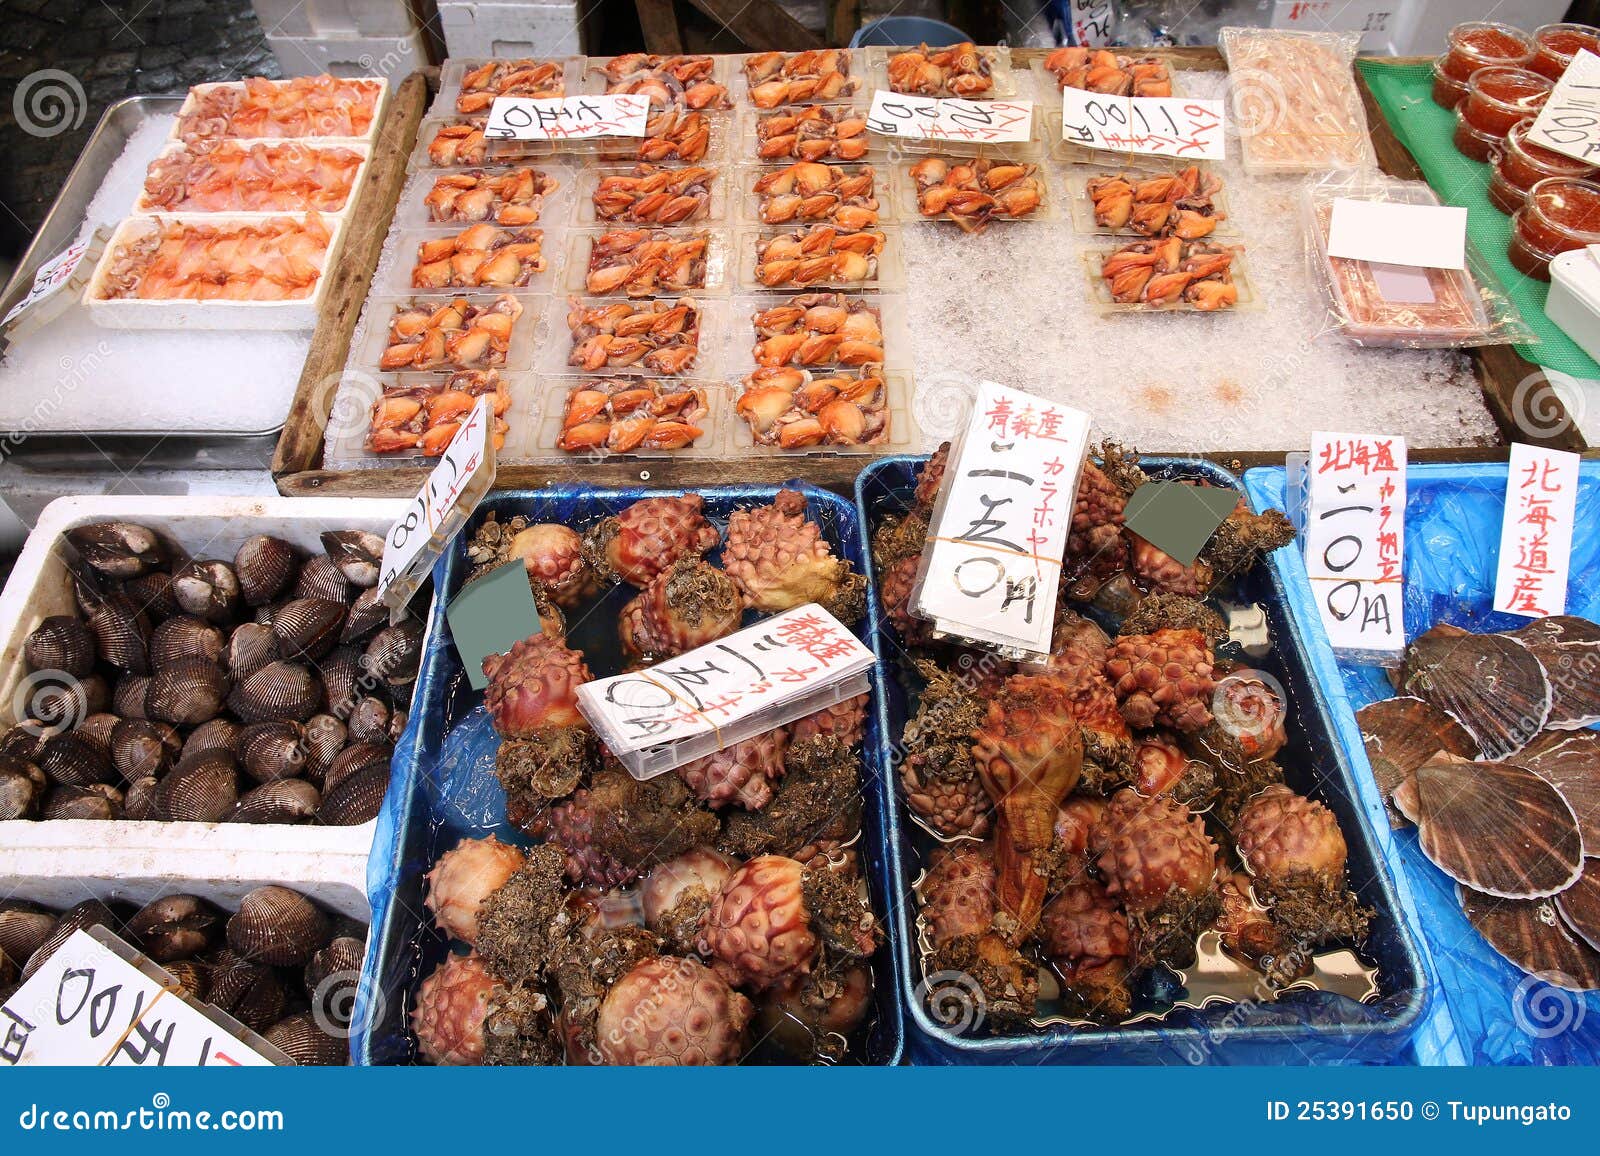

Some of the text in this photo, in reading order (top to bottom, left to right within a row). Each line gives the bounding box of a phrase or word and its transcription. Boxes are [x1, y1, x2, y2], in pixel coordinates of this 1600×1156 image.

[1026, 457, 1065, 582] カラホヤ
[1318, 440, 1399, 475] 北海道
[1505, 459, 1562, 616] 北海道産
